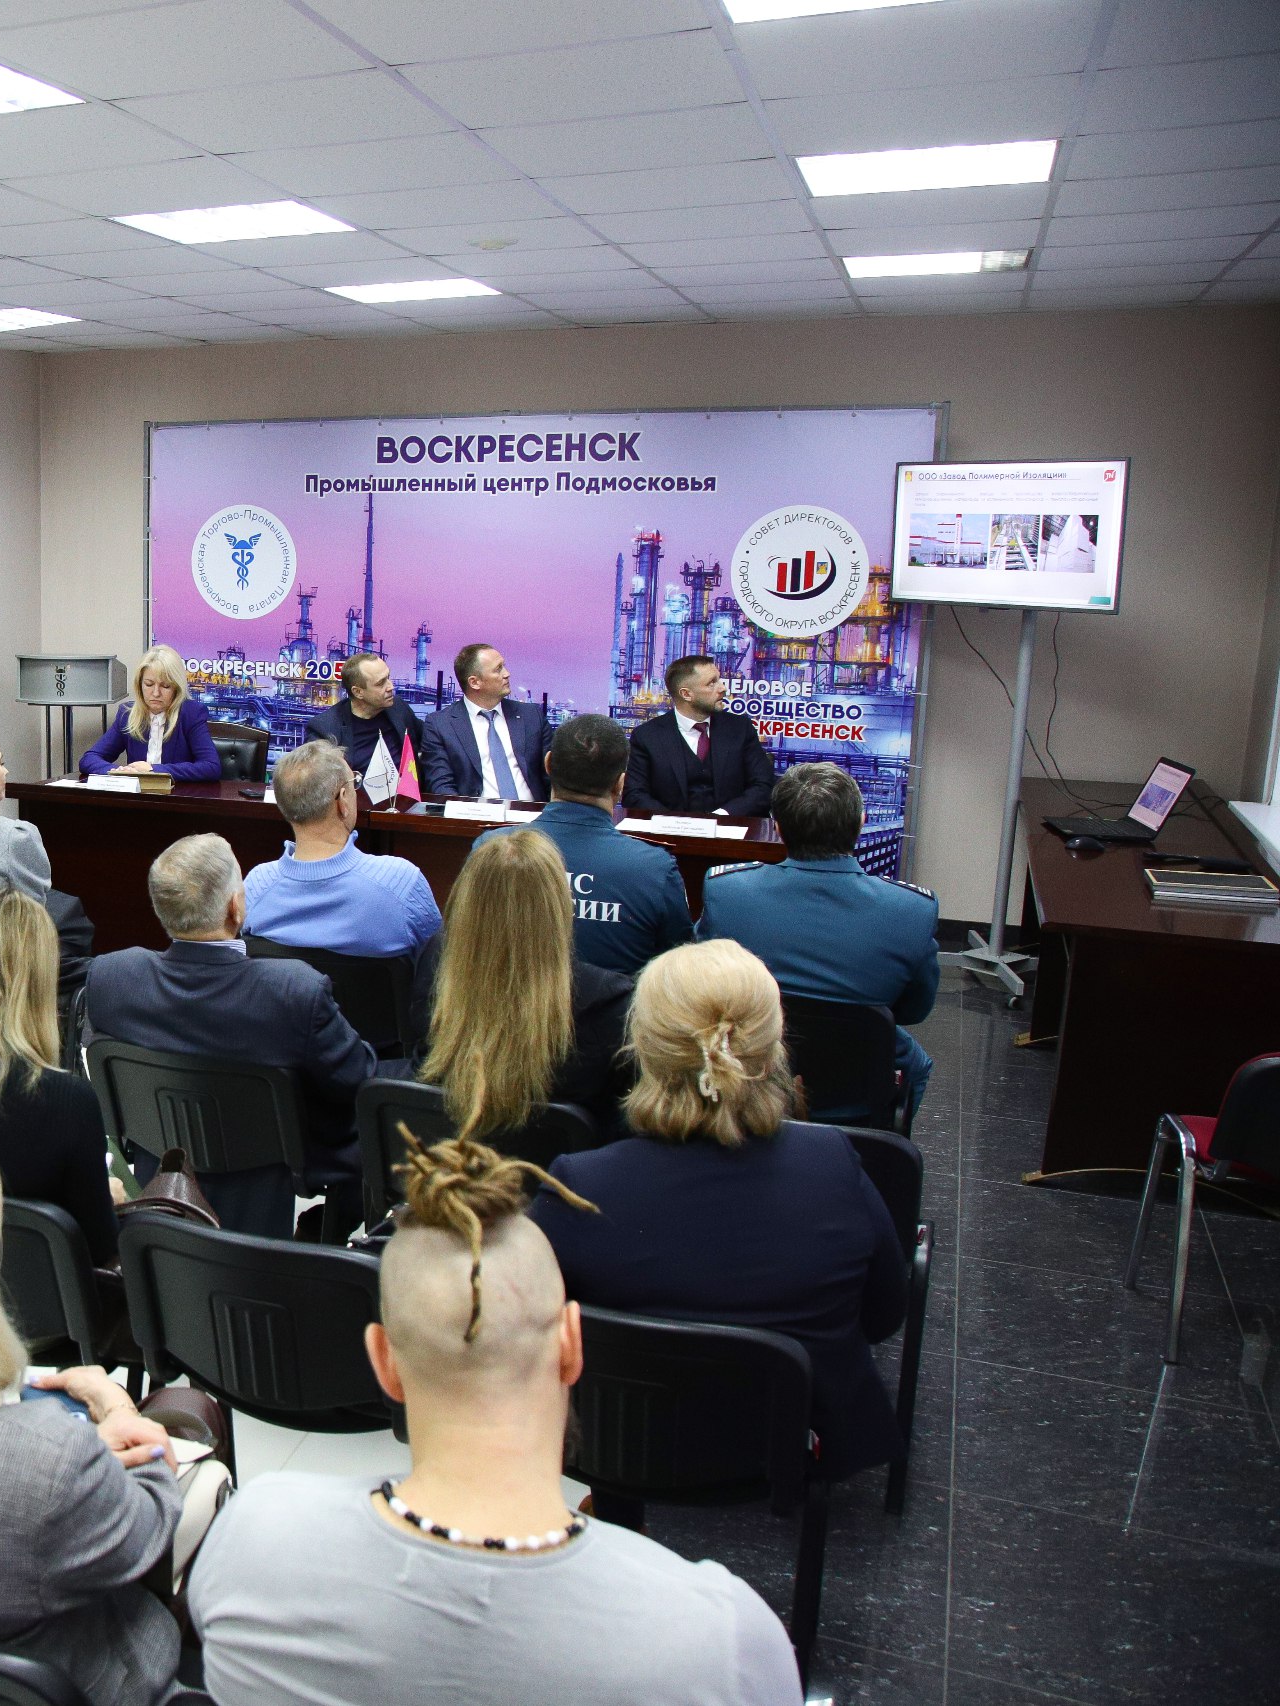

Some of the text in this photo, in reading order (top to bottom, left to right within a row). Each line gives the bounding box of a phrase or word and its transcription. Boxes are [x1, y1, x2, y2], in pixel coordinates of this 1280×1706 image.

[376, 433, 640, 463] ВОСКРЕСЕНСК
[305, 472, 716, 497] Промышленный центр Подмосковья
[917, 472, 938, 481] ООО
[968, 471, 1021, 482] Полимерной
[749, 512, 853, 546] СОВЕТ ДИРЕКТОРОВ
[198, 509, 291, 614] Воскресенская Торгово-Промышленная Палата
[738, 560, 861, 630] ГОРОДСКОГО ОКРУГА ВОСКРЕСЕНК
[181, 658, 301, 678] ОСКРЕСЕНСК
[572, 898, 623, 923] ИИ
